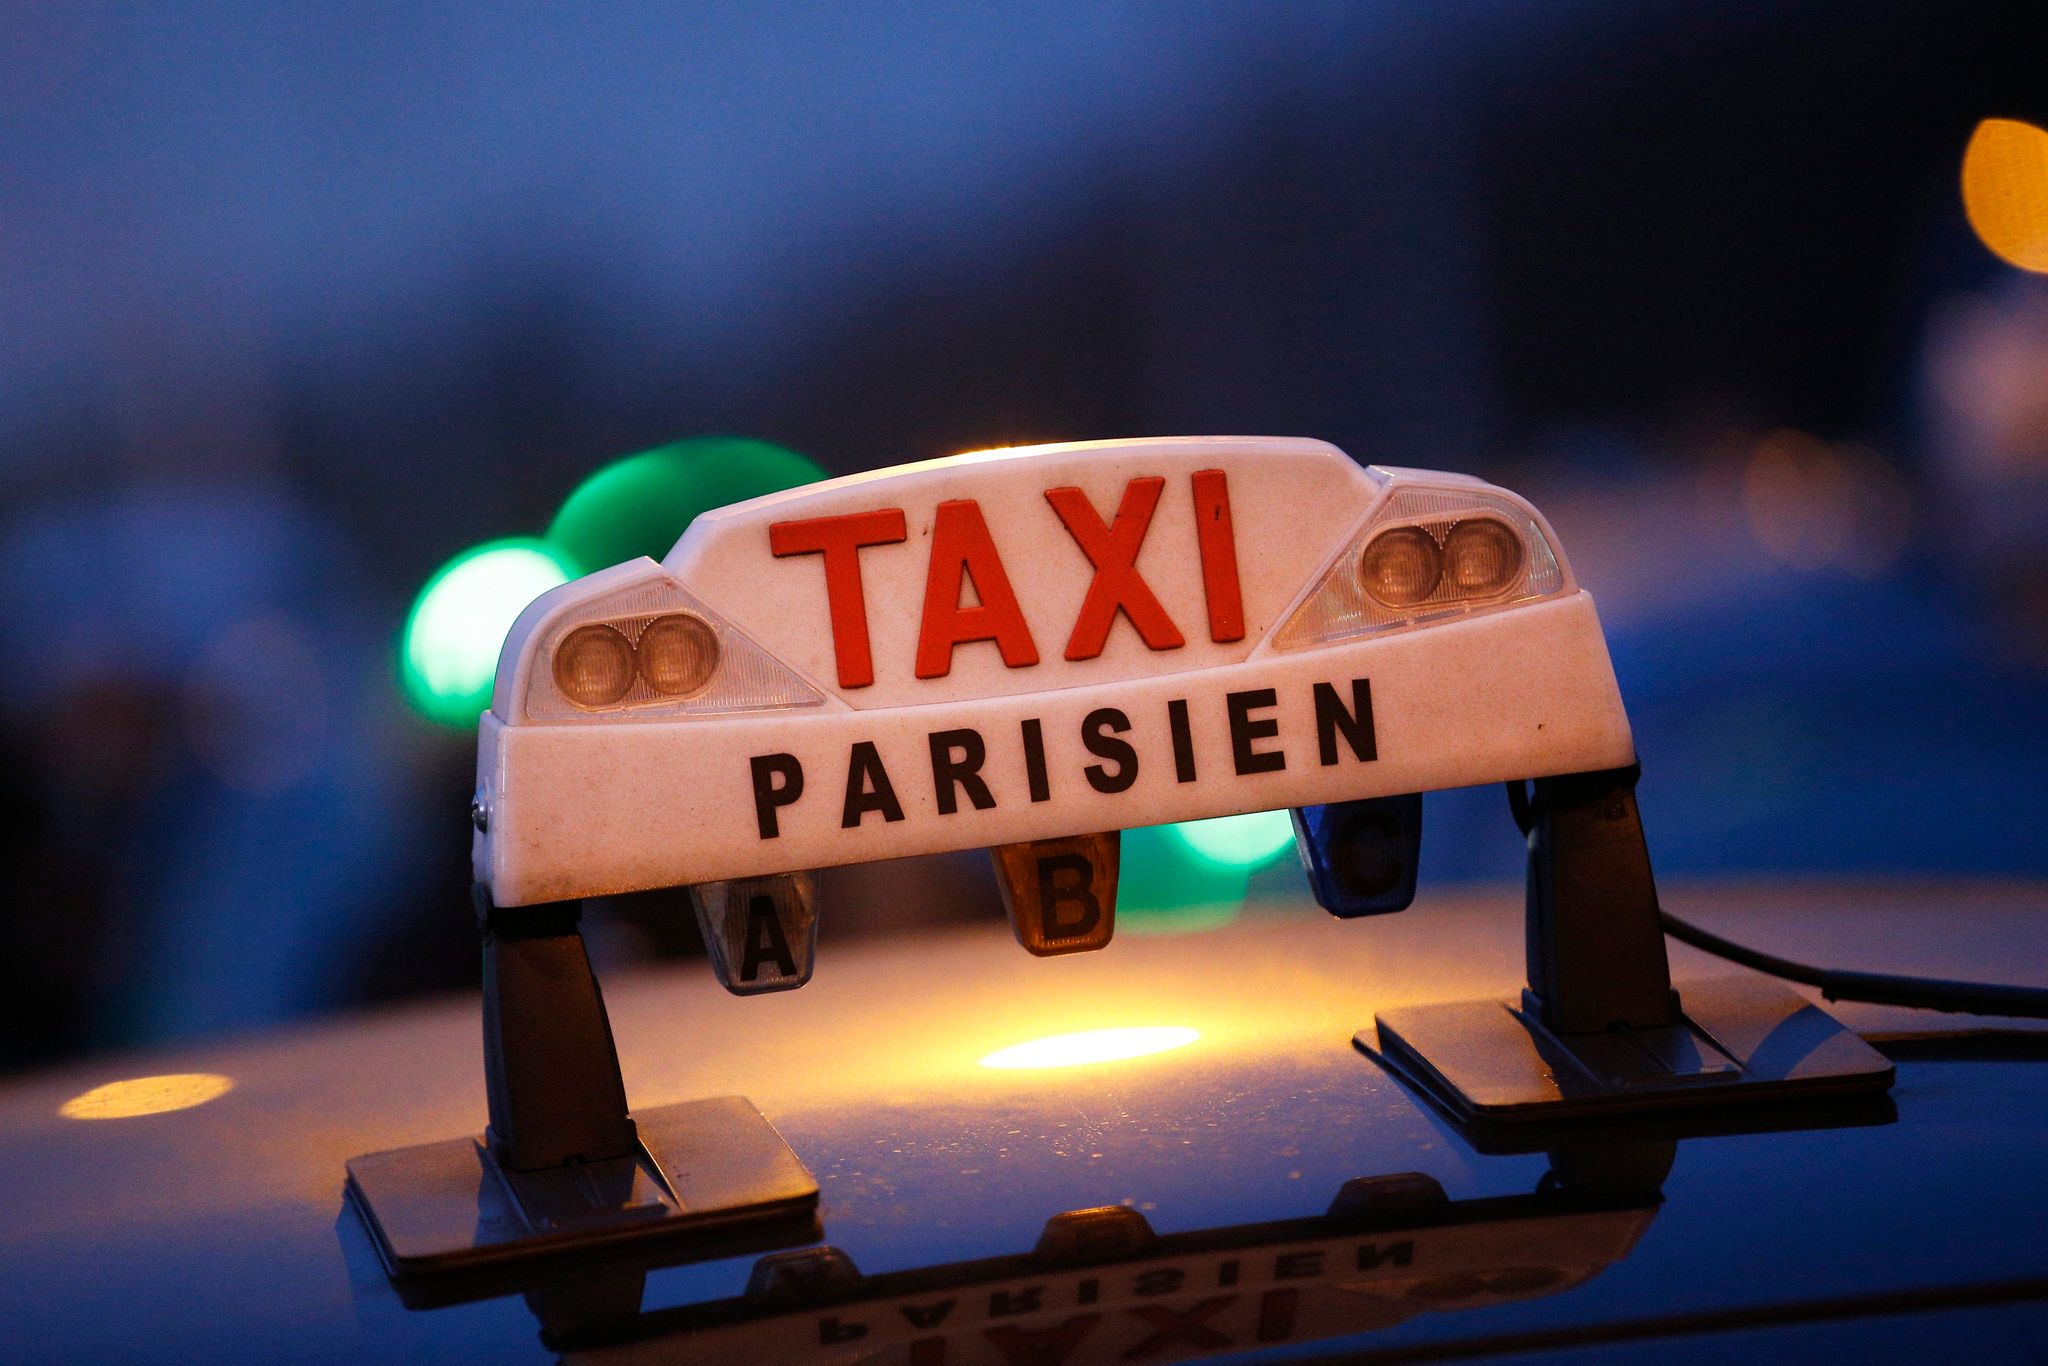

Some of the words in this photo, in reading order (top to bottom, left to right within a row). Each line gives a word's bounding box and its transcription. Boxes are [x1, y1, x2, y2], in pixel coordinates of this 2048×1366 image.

[769, 469, 1245, 689] TAXI
[750, 678, 1379, 840] PARISIEN
[1034, 855, 1102, 943] B
[1331, 814, 1404, 896] C
[740, 896, 798, 982] A
